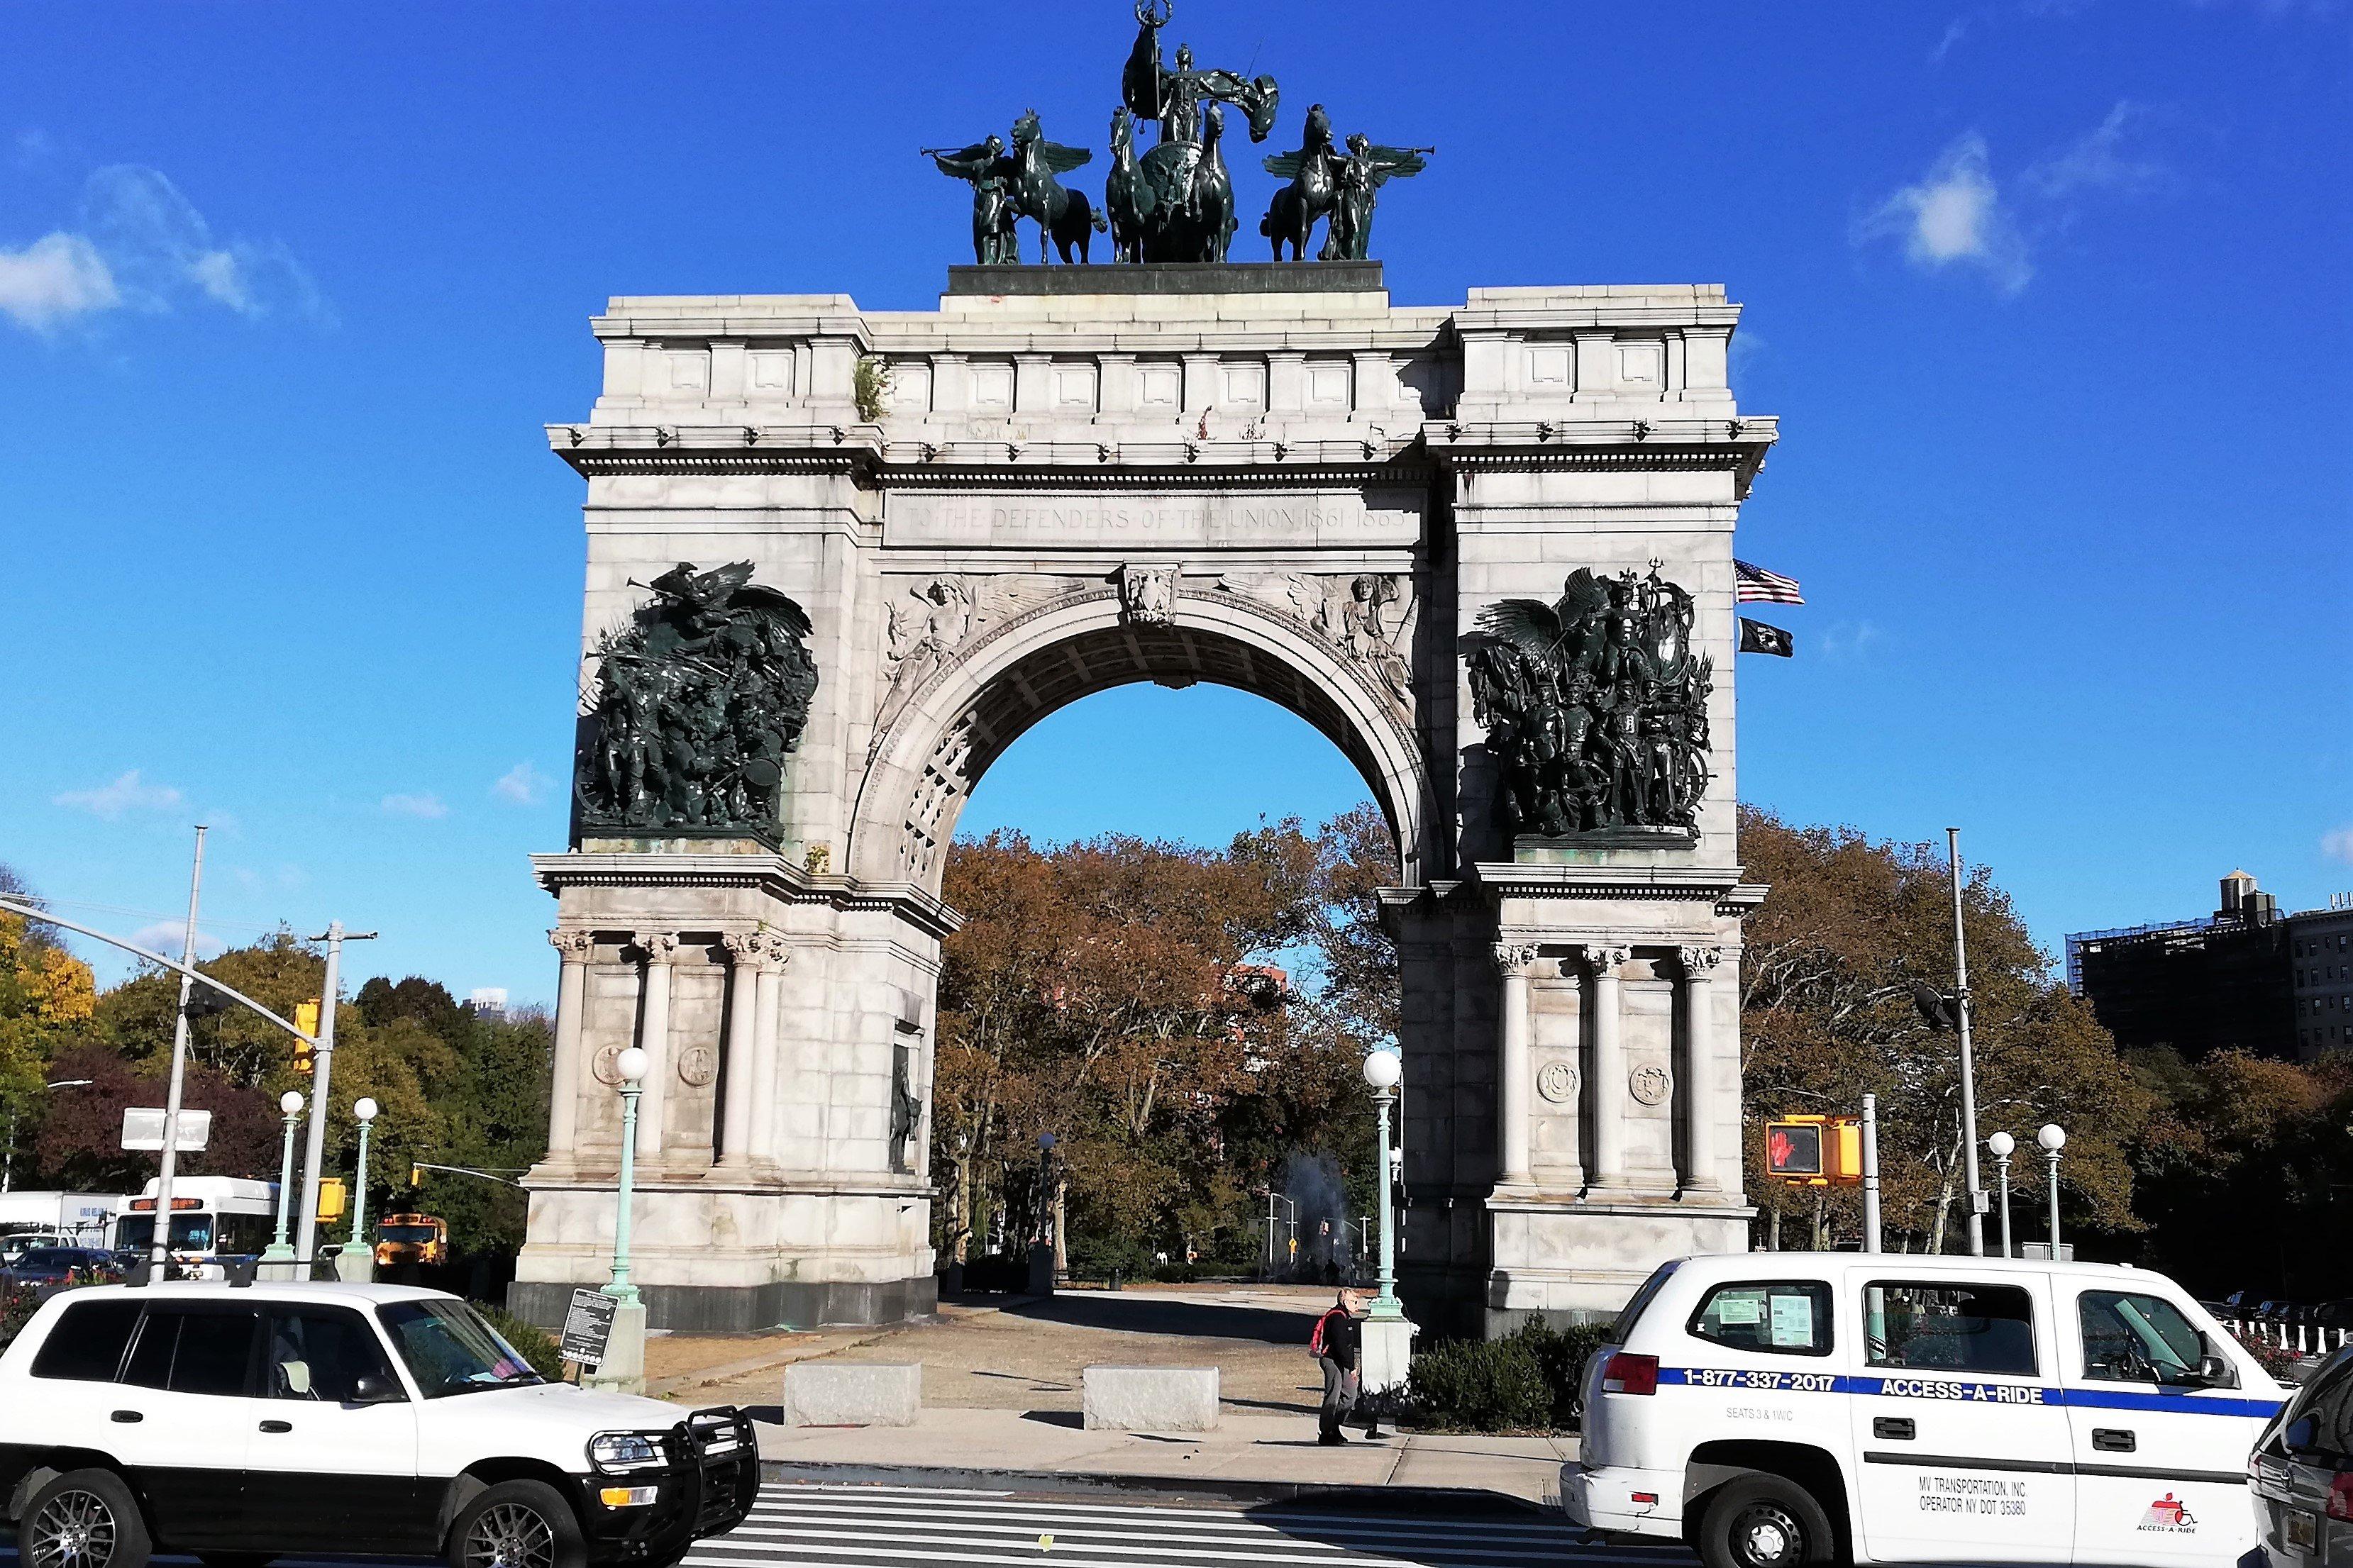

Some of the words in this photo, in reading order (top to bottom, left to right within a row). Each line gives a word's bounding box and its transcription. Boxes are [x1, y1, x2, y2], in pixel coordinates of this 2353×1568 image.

[906, 508, 932, 528] TO
[943, 508, 982, 528] THE
[992, 508, 1129, 529] DEFENDERS
[1141, 508, 1170, 529] OF
[1177, 508, 1222, 529] THE
[1229, 508, 1296, 528] UNION
[1305, 508, 1344, 528] 1861
[1683, 1369, 1835, 1391] 1-877-337-2017
[1881, 1378, 2044, 1405] ACCESS-A-RIDE
[1726, 1407, 1755, 1419] SEATS
[1756, 1408, 1762, 1420] 3
[1764, 1409, 1770, 1420] &
[1919, 1476, 1931, 1491] MV
[1934, 1477, 2009, 1496] TRANSPORTATION,
[2011, 1481, 2028, 1498] INC.
[1920, 1496, 1963, 1513] OPERATOR
[1966, 1498, 1977, 1513] NY
[1980, 1499, 1997, 1515] DOT
[2000, 1500, 2026, 1516] 35380
[2137, 1525, 2196, 1534] ACCESS-A-RIDE
